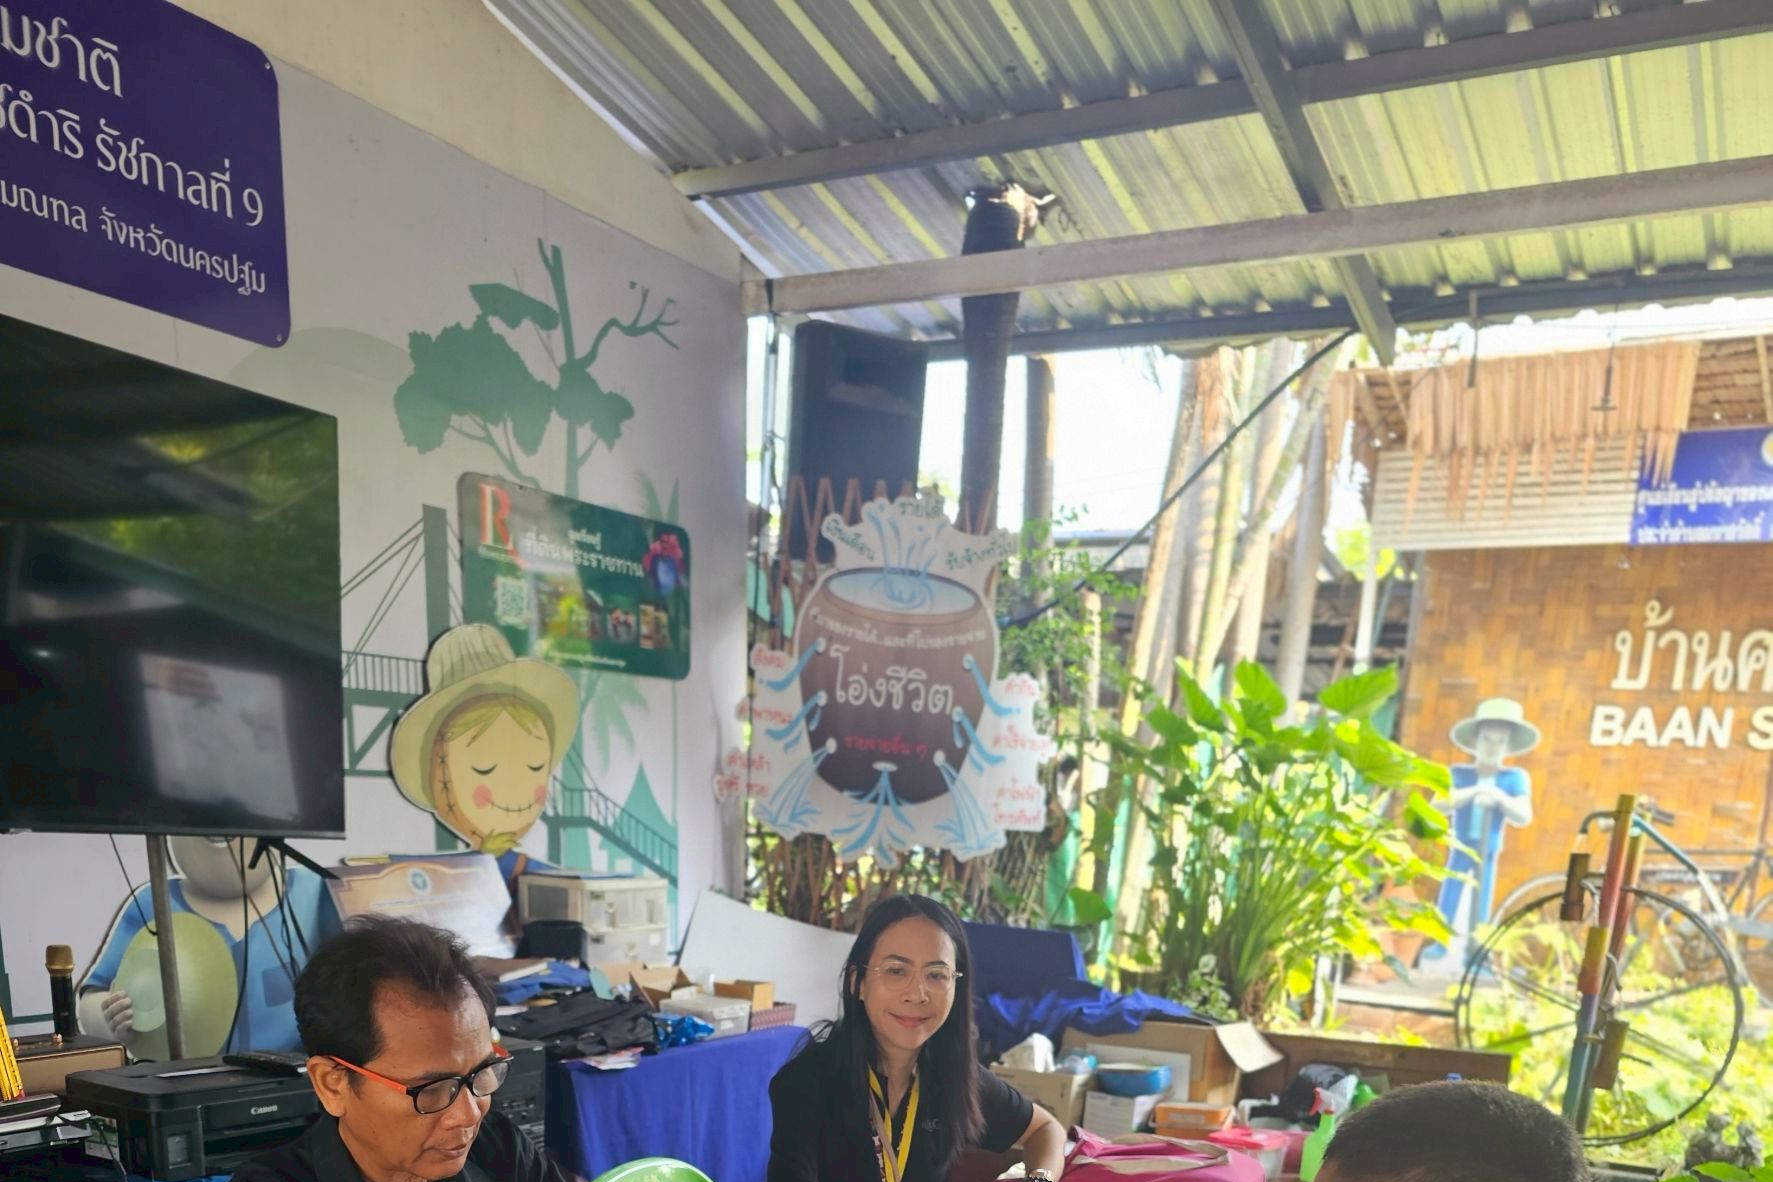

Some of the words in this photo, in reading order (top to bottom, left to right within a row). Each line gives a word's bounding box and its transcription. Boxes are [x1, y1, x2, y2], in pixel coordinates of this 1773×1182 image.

[95, 117, 234, 219] รัชกาลที่
[242, 187, 265, 228] 9
[98, 206, 267, 297] จังหวัดนครปฐม
[829, 643, 954, 716] โอ่งชีวิต
[1589, 703, 1735, 749] BAAN
[250, 1104, 278, 1116] Canon
